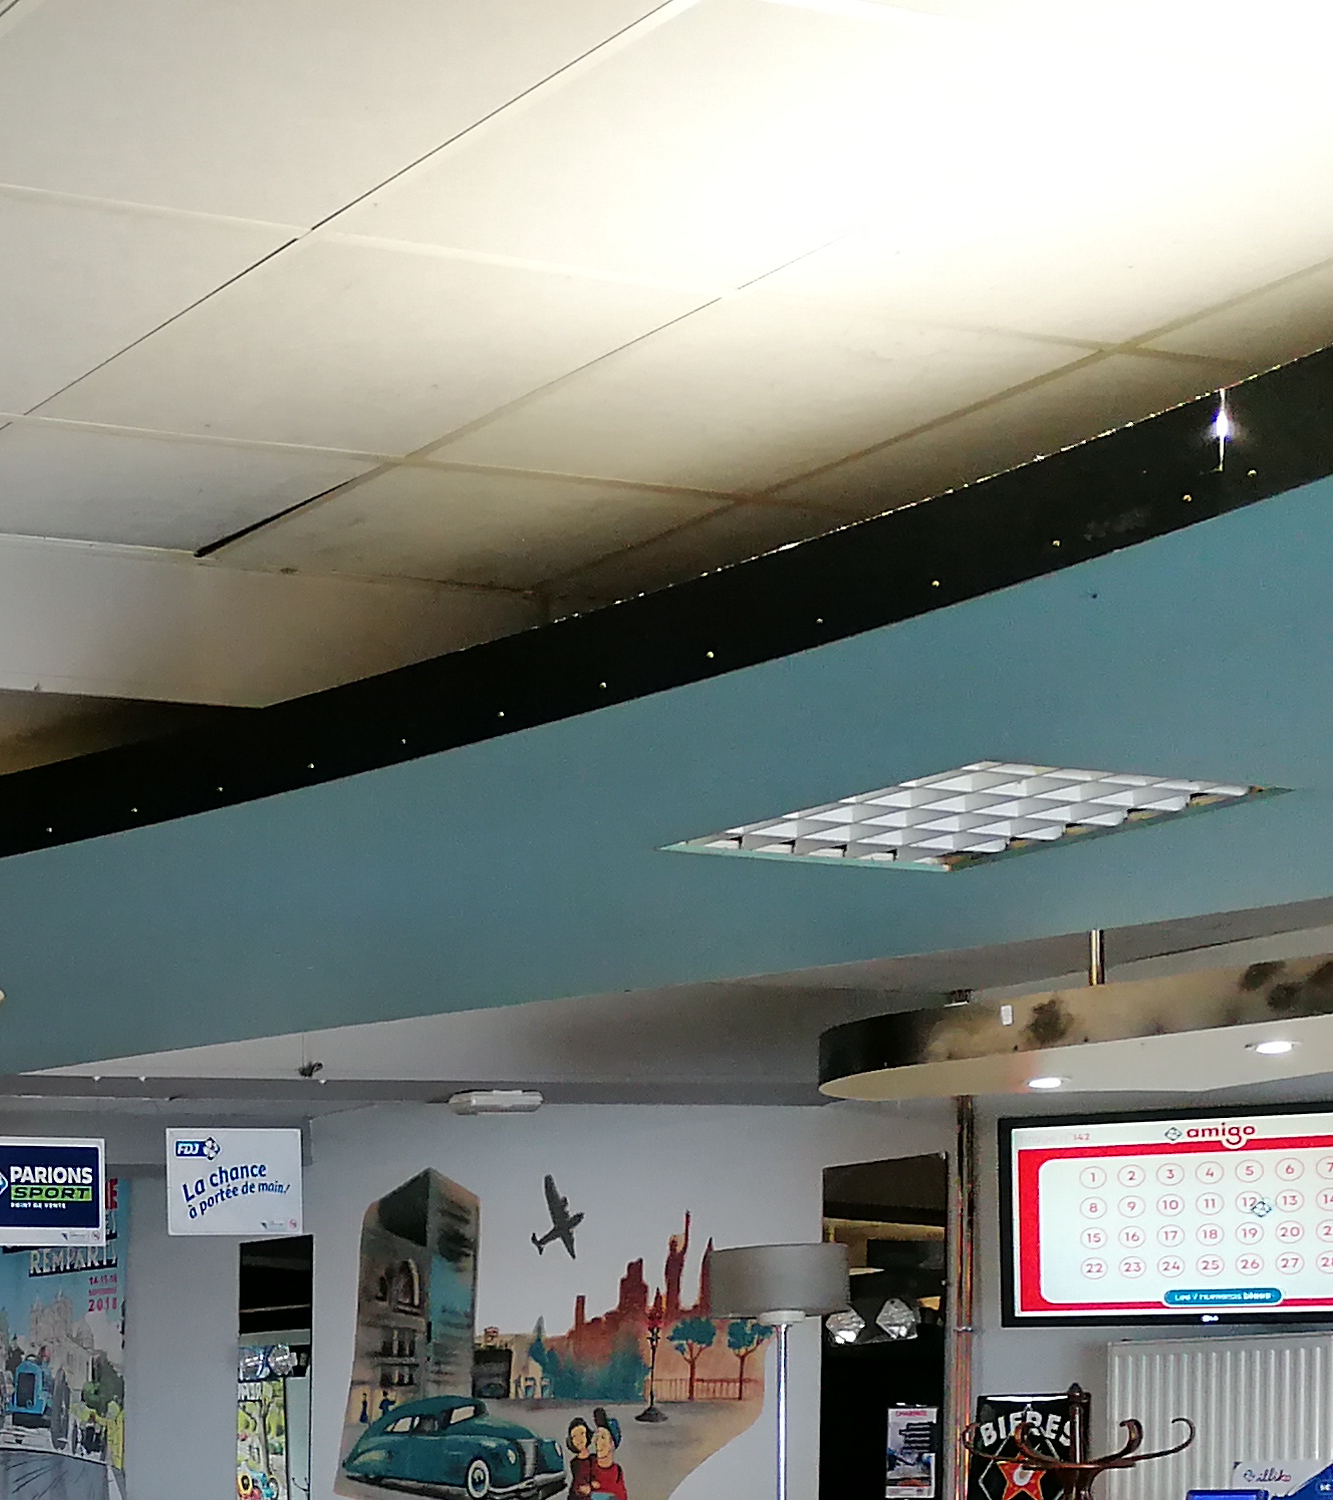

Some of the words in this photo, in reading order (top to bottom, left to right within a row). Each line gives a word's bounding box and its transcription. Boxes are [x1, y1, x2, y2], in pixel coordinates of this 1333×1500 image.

[1187, 1122, 1256, 1145] amigo
[177, 1143, 199, 1154] FDJ
[10, 1166, 93, 1184] PARIONS
[182, 1179, 206, 1202] La
[209, 1164, 267, 1187] chance
[1091, 1173, 1096, 1183] 1
[1128, 1171, 1136, 1180] 2
[1167, 1169, 1175, 1179] 3
[1206, 1168, 1214, 1178] 4
[1245, 1166, 1254, 1176] 5
[1286, 1165, 1295, 1175] 6
[13, 1186, 90, 1200] SPORT
[188, 1204, 198, 1219] à
[199, 1184, 239, 1215] portée
[241, 1181, 255, 1195] de
[1089, 1203, 1098, 1213] 8
[1127, 1202, 1136, 1211] 9
[1163, 1200, 1179, 1210] 10
[1205, 1199, 1215, 1209] 11
[1242, 1197, 1257, 1207] 12
[1283, 1195, 1298, 1206] 13
[1088, 1233, 1101, 1243] 15
[1125, 1232, 1140, 1242] 16
[1164, 1231, 1178, 1241] 17
[1203, 1229, 1218, 1239] 18
[1242, 1228, 1258, 1238] 19
[1280, 1226, 1300, 1237] 20
[1086, 1263, 1103, 1273] 22
[1124, 1262, 1142, 1272] 23
[1163, 1261, 1181, 1271] 24
[1202, 1260, 1220, 1270] 25
[1241, 1259, 1260, 1269] 26
[1281, 1258, 1300, 1268] 27
[88, 1298, 118, 1312] 2018
